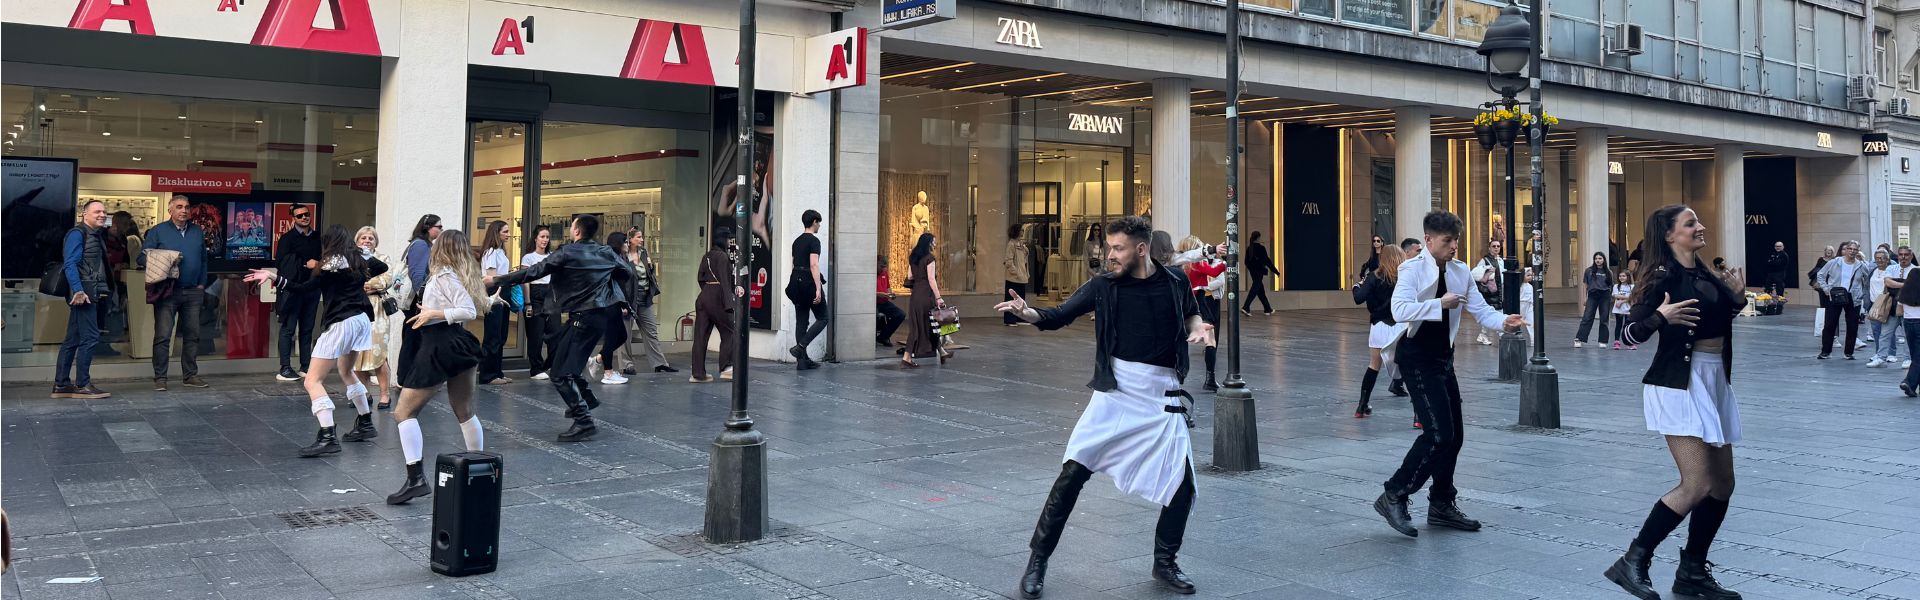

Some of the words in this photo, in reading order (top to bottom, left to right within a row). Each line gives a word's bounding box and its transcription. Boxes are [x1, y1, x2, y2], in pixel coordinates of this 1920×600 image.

[996, 17, 1043, 49] ZARA
[826, 36, 852, 81] A1
[1817, 132, 1832, 148] ZARA
[1863, 141, 1889, 152] ZARA
[157, 176, 222, 187] Ekskluzivno
[1302, 202, 1320, 215] ZARA
[1745, 214, 1768, 225] ZARA
